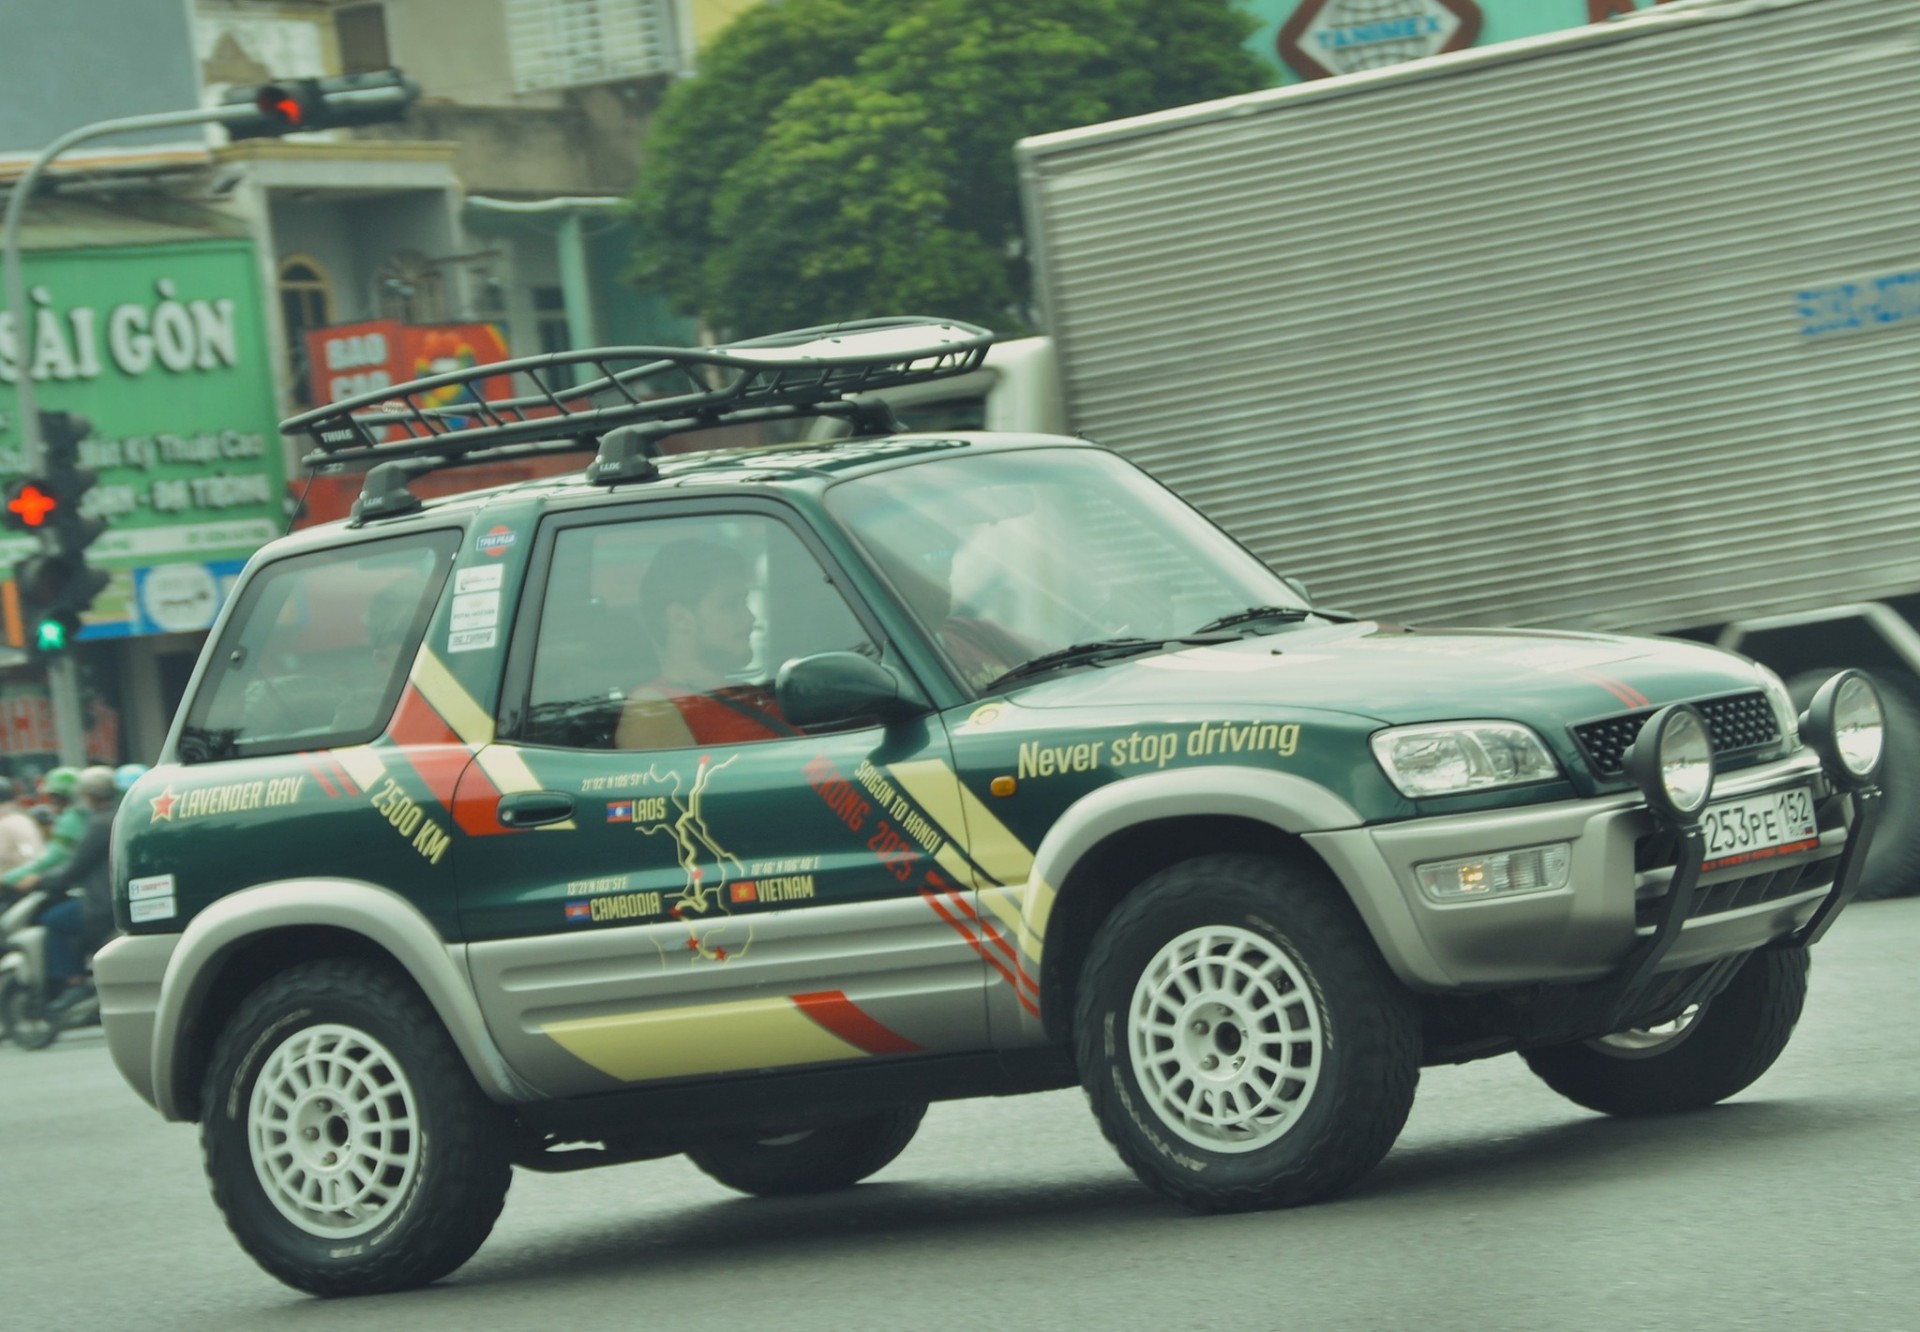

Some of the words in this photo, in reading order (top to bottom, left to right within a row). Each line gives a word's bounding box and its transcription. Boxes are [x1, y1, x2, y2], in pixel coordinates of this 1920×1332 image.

[109, 277, 237, 376] GÒN
[320, 428, 353, 443] THULE
[1018, 740, 1103, 779] Never
[1110, 731, 1178, 768] stop
[1186, 720, 1300, 757] driving
[179, 781, 264, 819] LAVENDER
[264, 776, 304, 807] RAV
[631, 797, 666, 823] LAOS
[854, 759, 896, 808] SAIGON
[889, 795, 909, 821] TO
[902, 809, 942, 854] HANOI
[1778, 791, 1810, 826] 152
[370, 778, 422, 837] 2500
[412, 818, 450, 865] KM
[867, 820, 920, 881] 2025
[590, 892, 661, 921] CAMBODIA
[755, 875, 815, 903] VIETNAM
